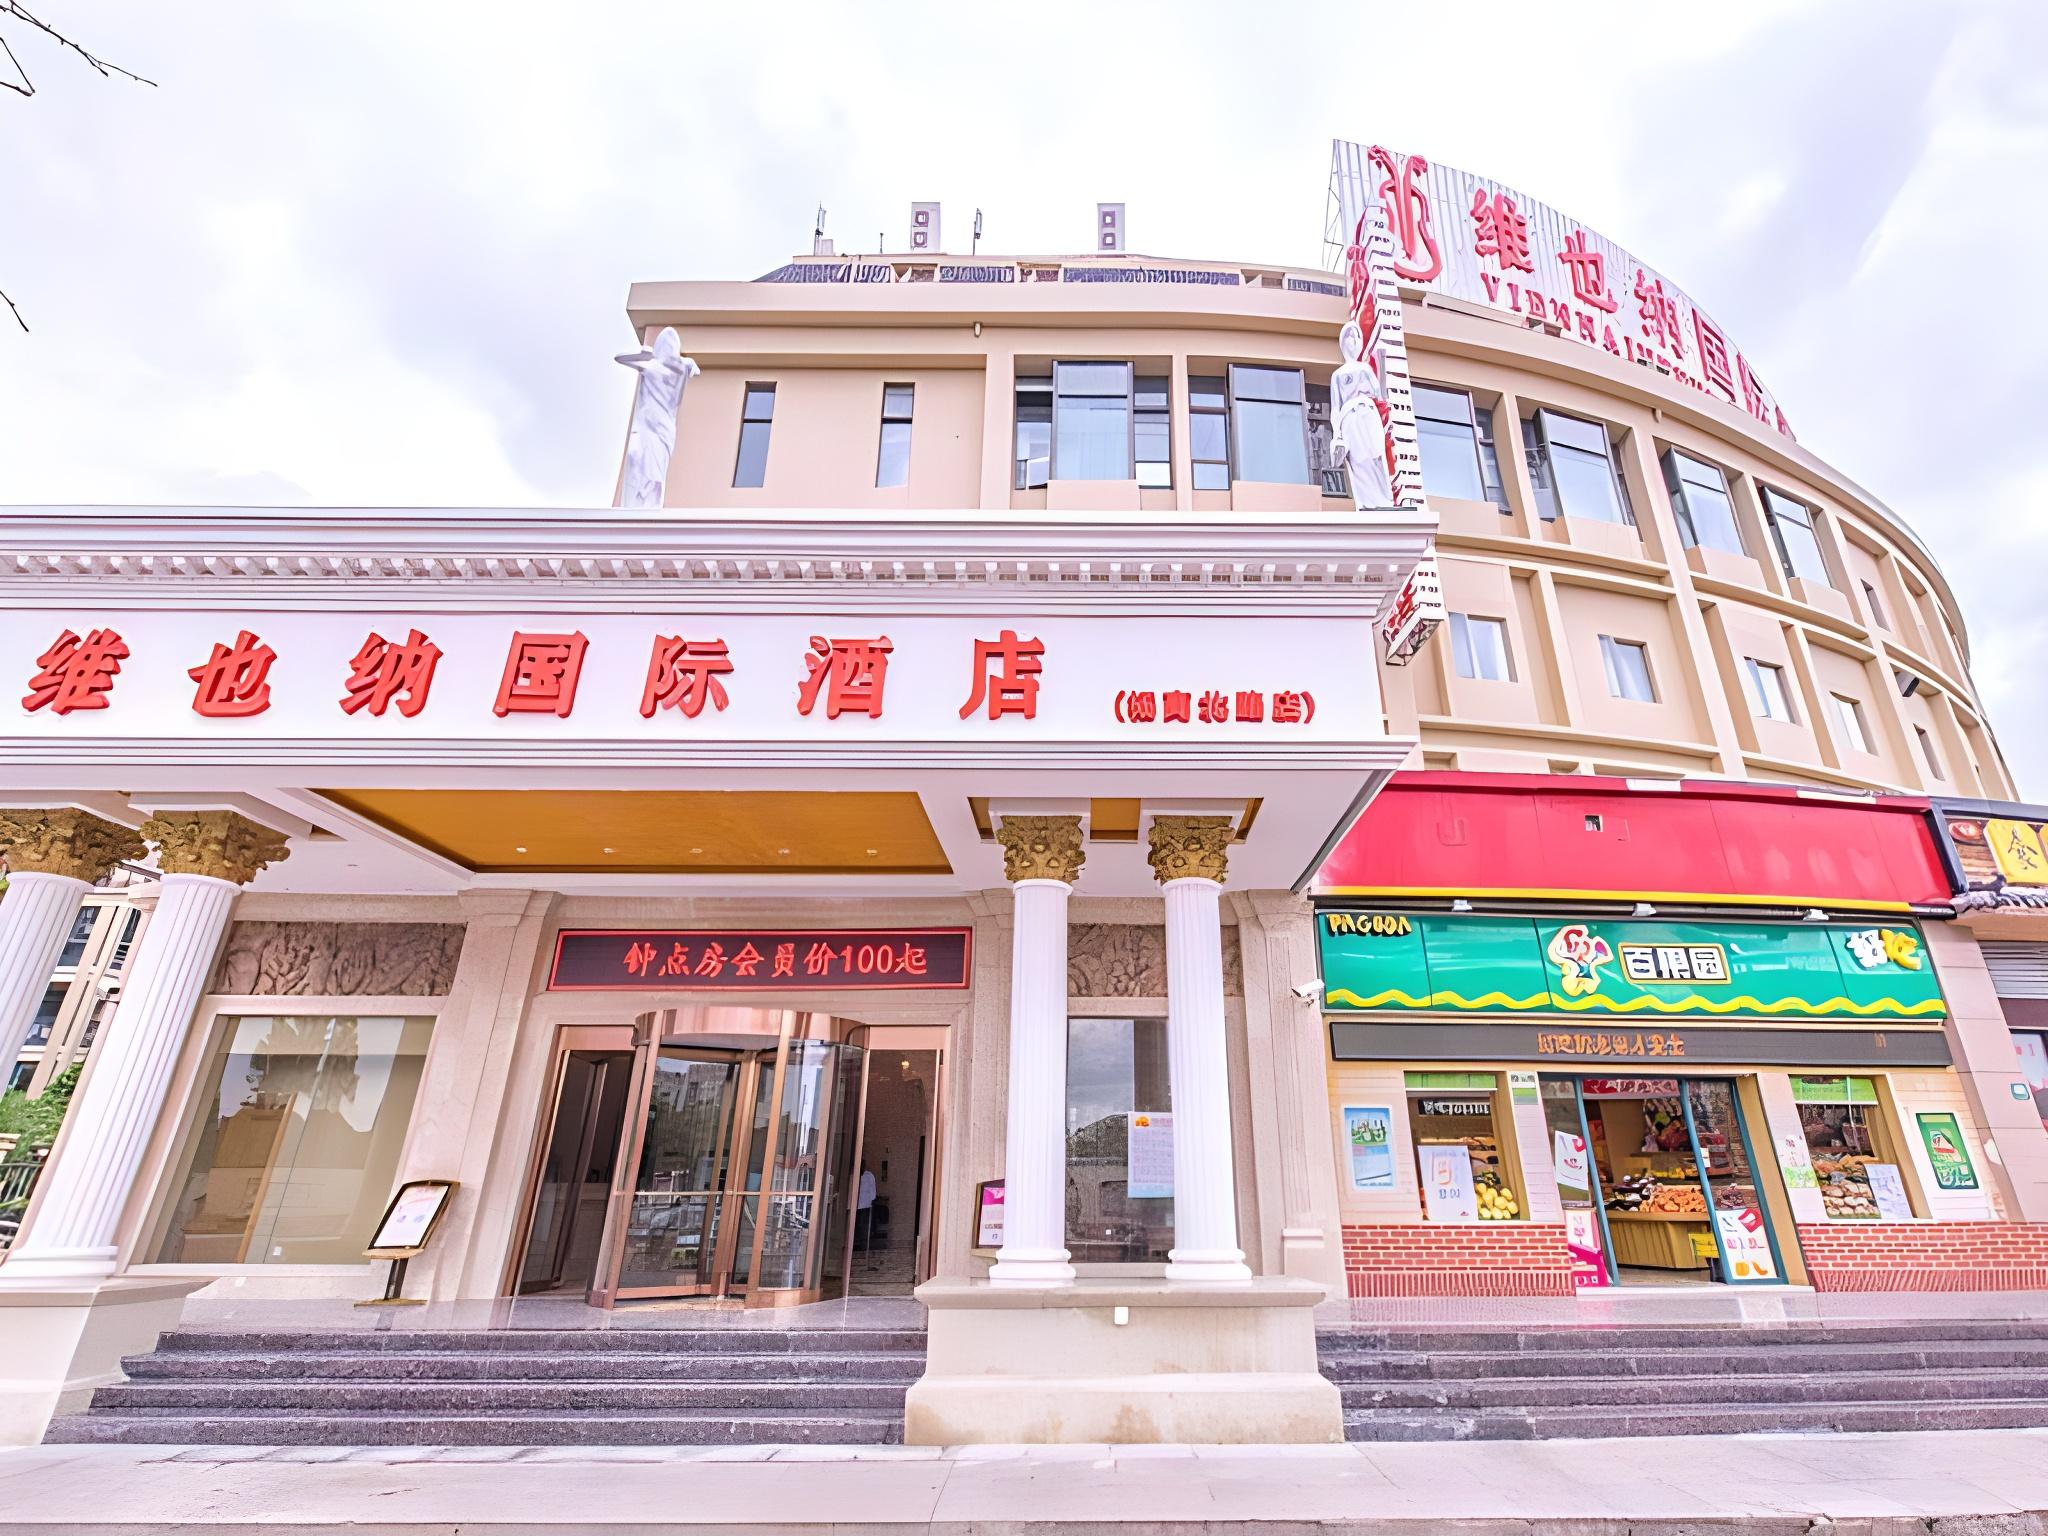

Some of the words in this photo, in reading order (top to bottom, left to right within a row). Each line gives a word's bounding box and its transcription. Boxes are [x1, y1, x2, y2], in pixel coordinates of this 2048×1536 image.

[21, 627, 1046, 720] 维也纳国际酒店
[623, 941, 928, 978] 钟点房会员价100起
